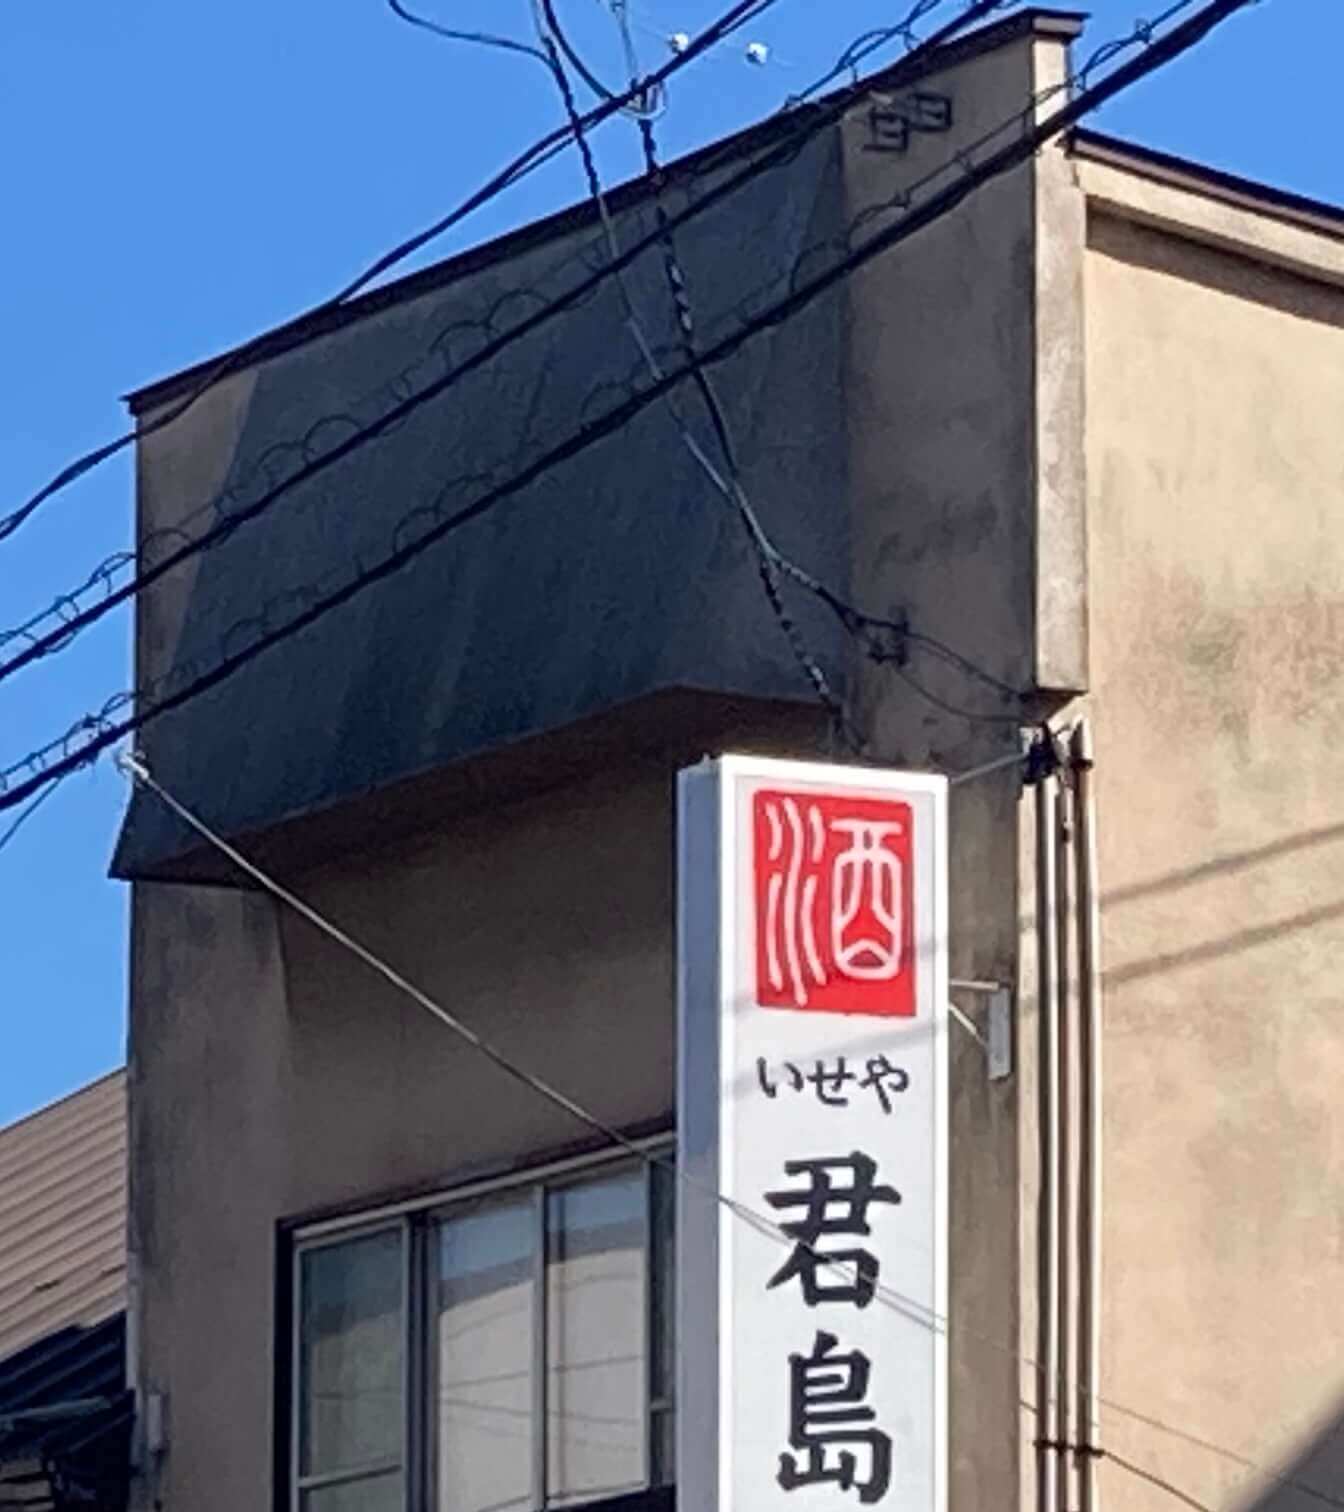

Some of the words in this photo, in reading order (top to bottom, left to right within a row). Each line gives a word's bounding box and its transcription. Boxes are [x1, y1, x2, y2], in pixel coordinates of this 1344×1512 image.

[765, 794, 902, 1006] 酒
[757, 1056, 909, 1114] いせや
